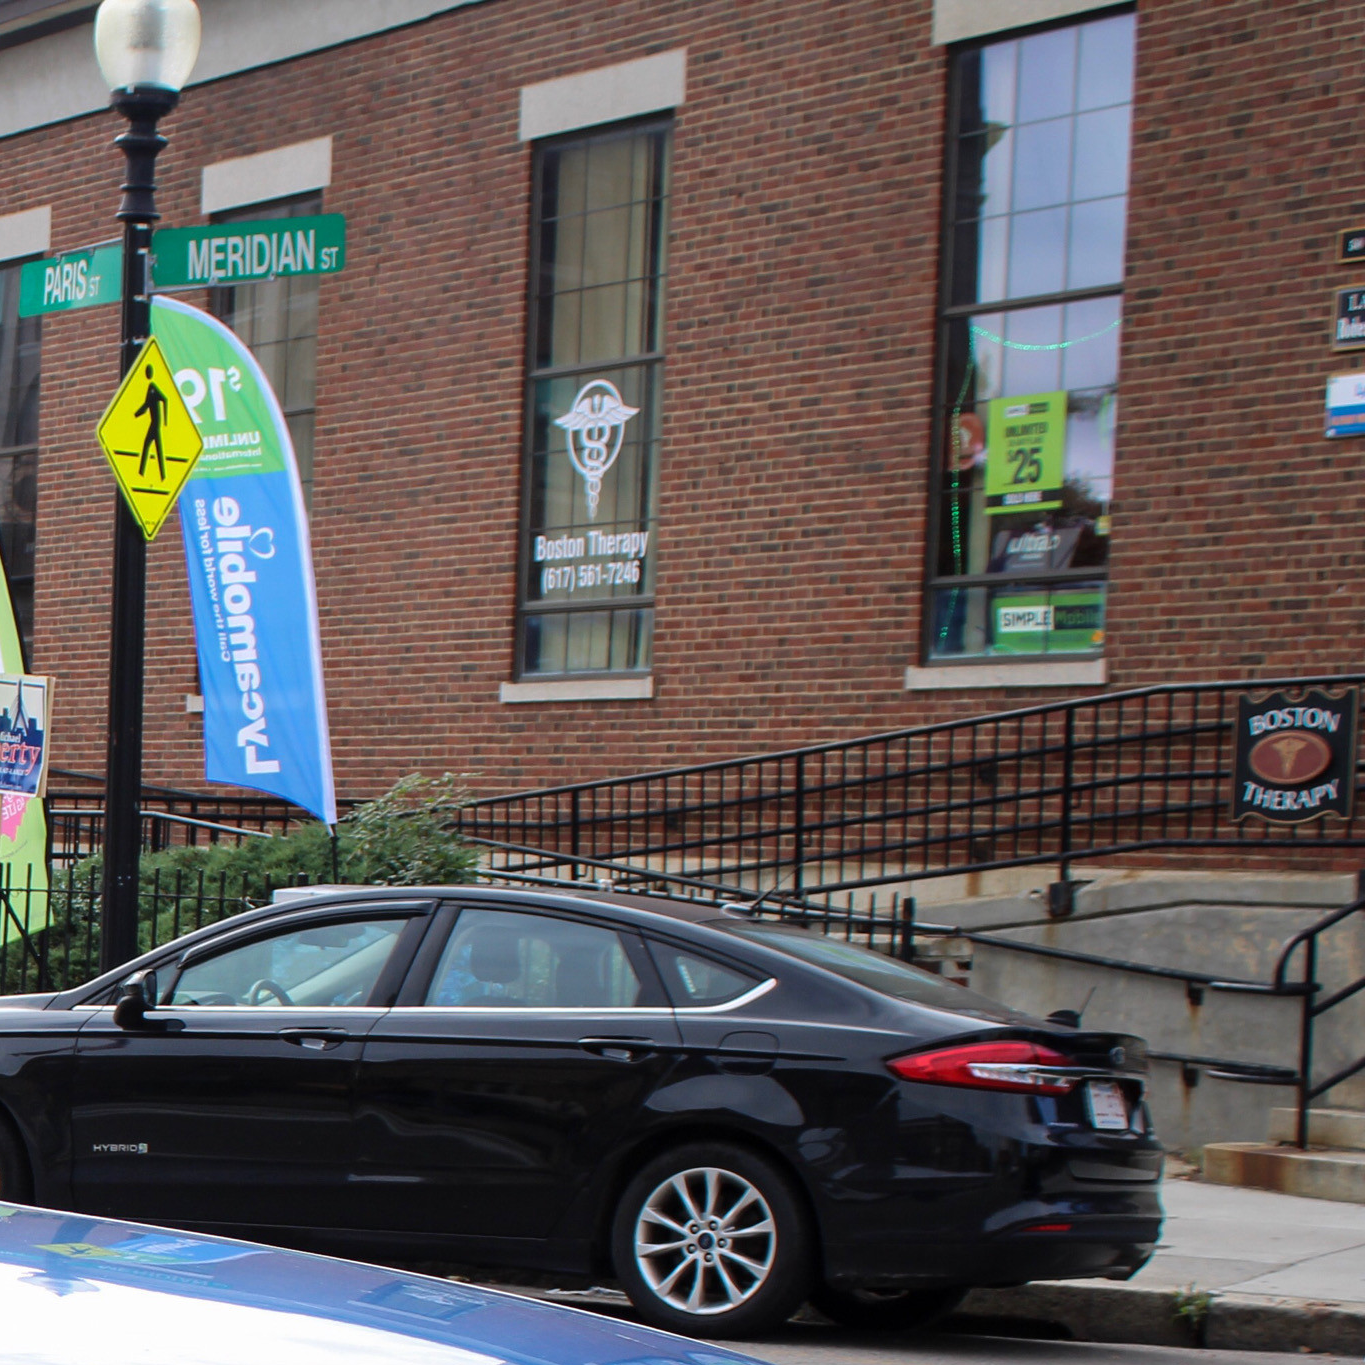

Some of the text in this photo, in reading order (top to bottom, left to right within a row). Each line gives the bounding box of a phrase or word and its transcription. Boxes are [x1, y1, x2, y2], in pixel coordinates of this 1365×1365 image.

[187, 229, 339, 281] MERIDIAN ST
[43, 259, 100, 306] PARIS ST
[534, 530, 649, 562] Boston Therapy
[541, 560, 641, 594] (617) 561-7246
[1003, 611, 1052, 627] SIMPLE
[1249, 707, 1342, 736] BOSTON
[1242, 779, 1340, 811] THERAPY
[93, 1143, 138, 1152] HYBRID
